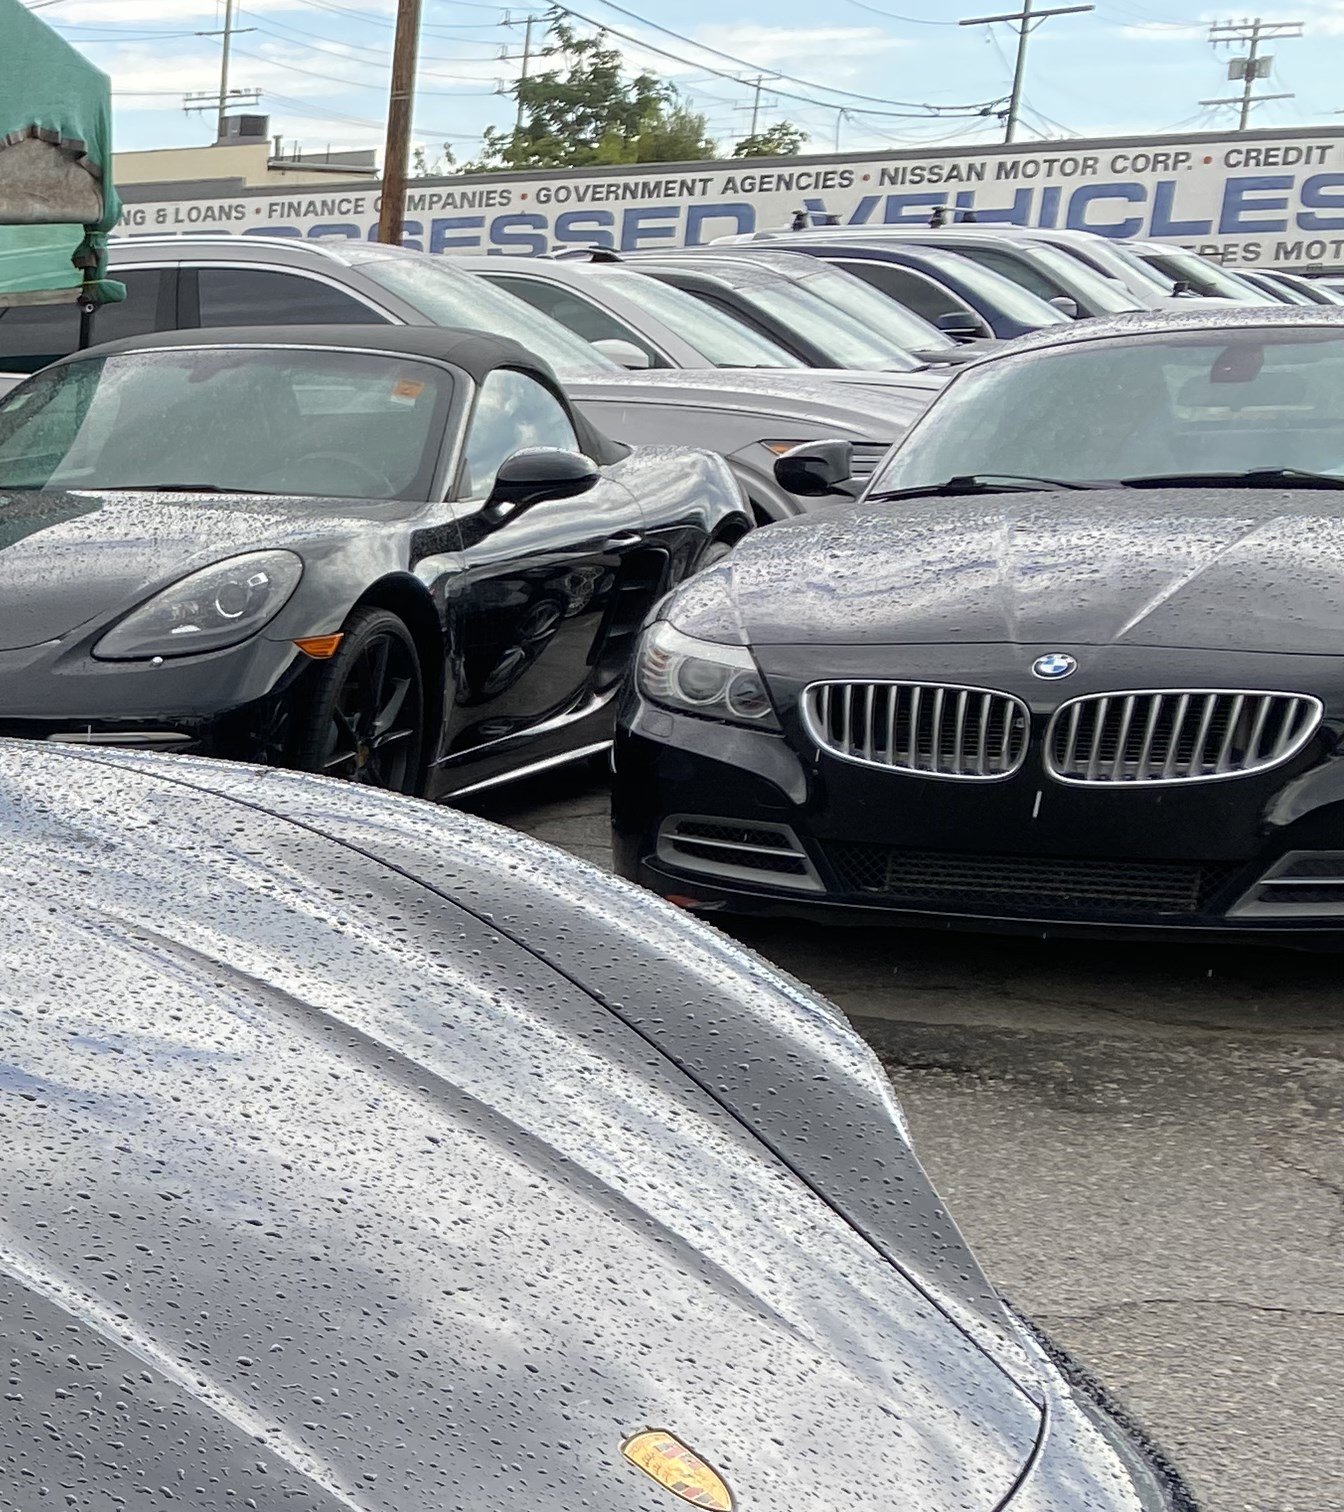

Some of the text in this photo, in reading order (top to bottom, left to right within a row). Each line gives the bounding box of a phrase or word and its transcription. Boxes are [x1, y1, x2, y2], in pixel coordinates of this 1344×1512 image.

[117, 145, 1334, 226] NG & LOANS FINANCE CMPANIES GOVERNMENT AGENCIES NISSAN MOTOR CORP. CREDIT
[1274, 240, 1344, 261] MOT
